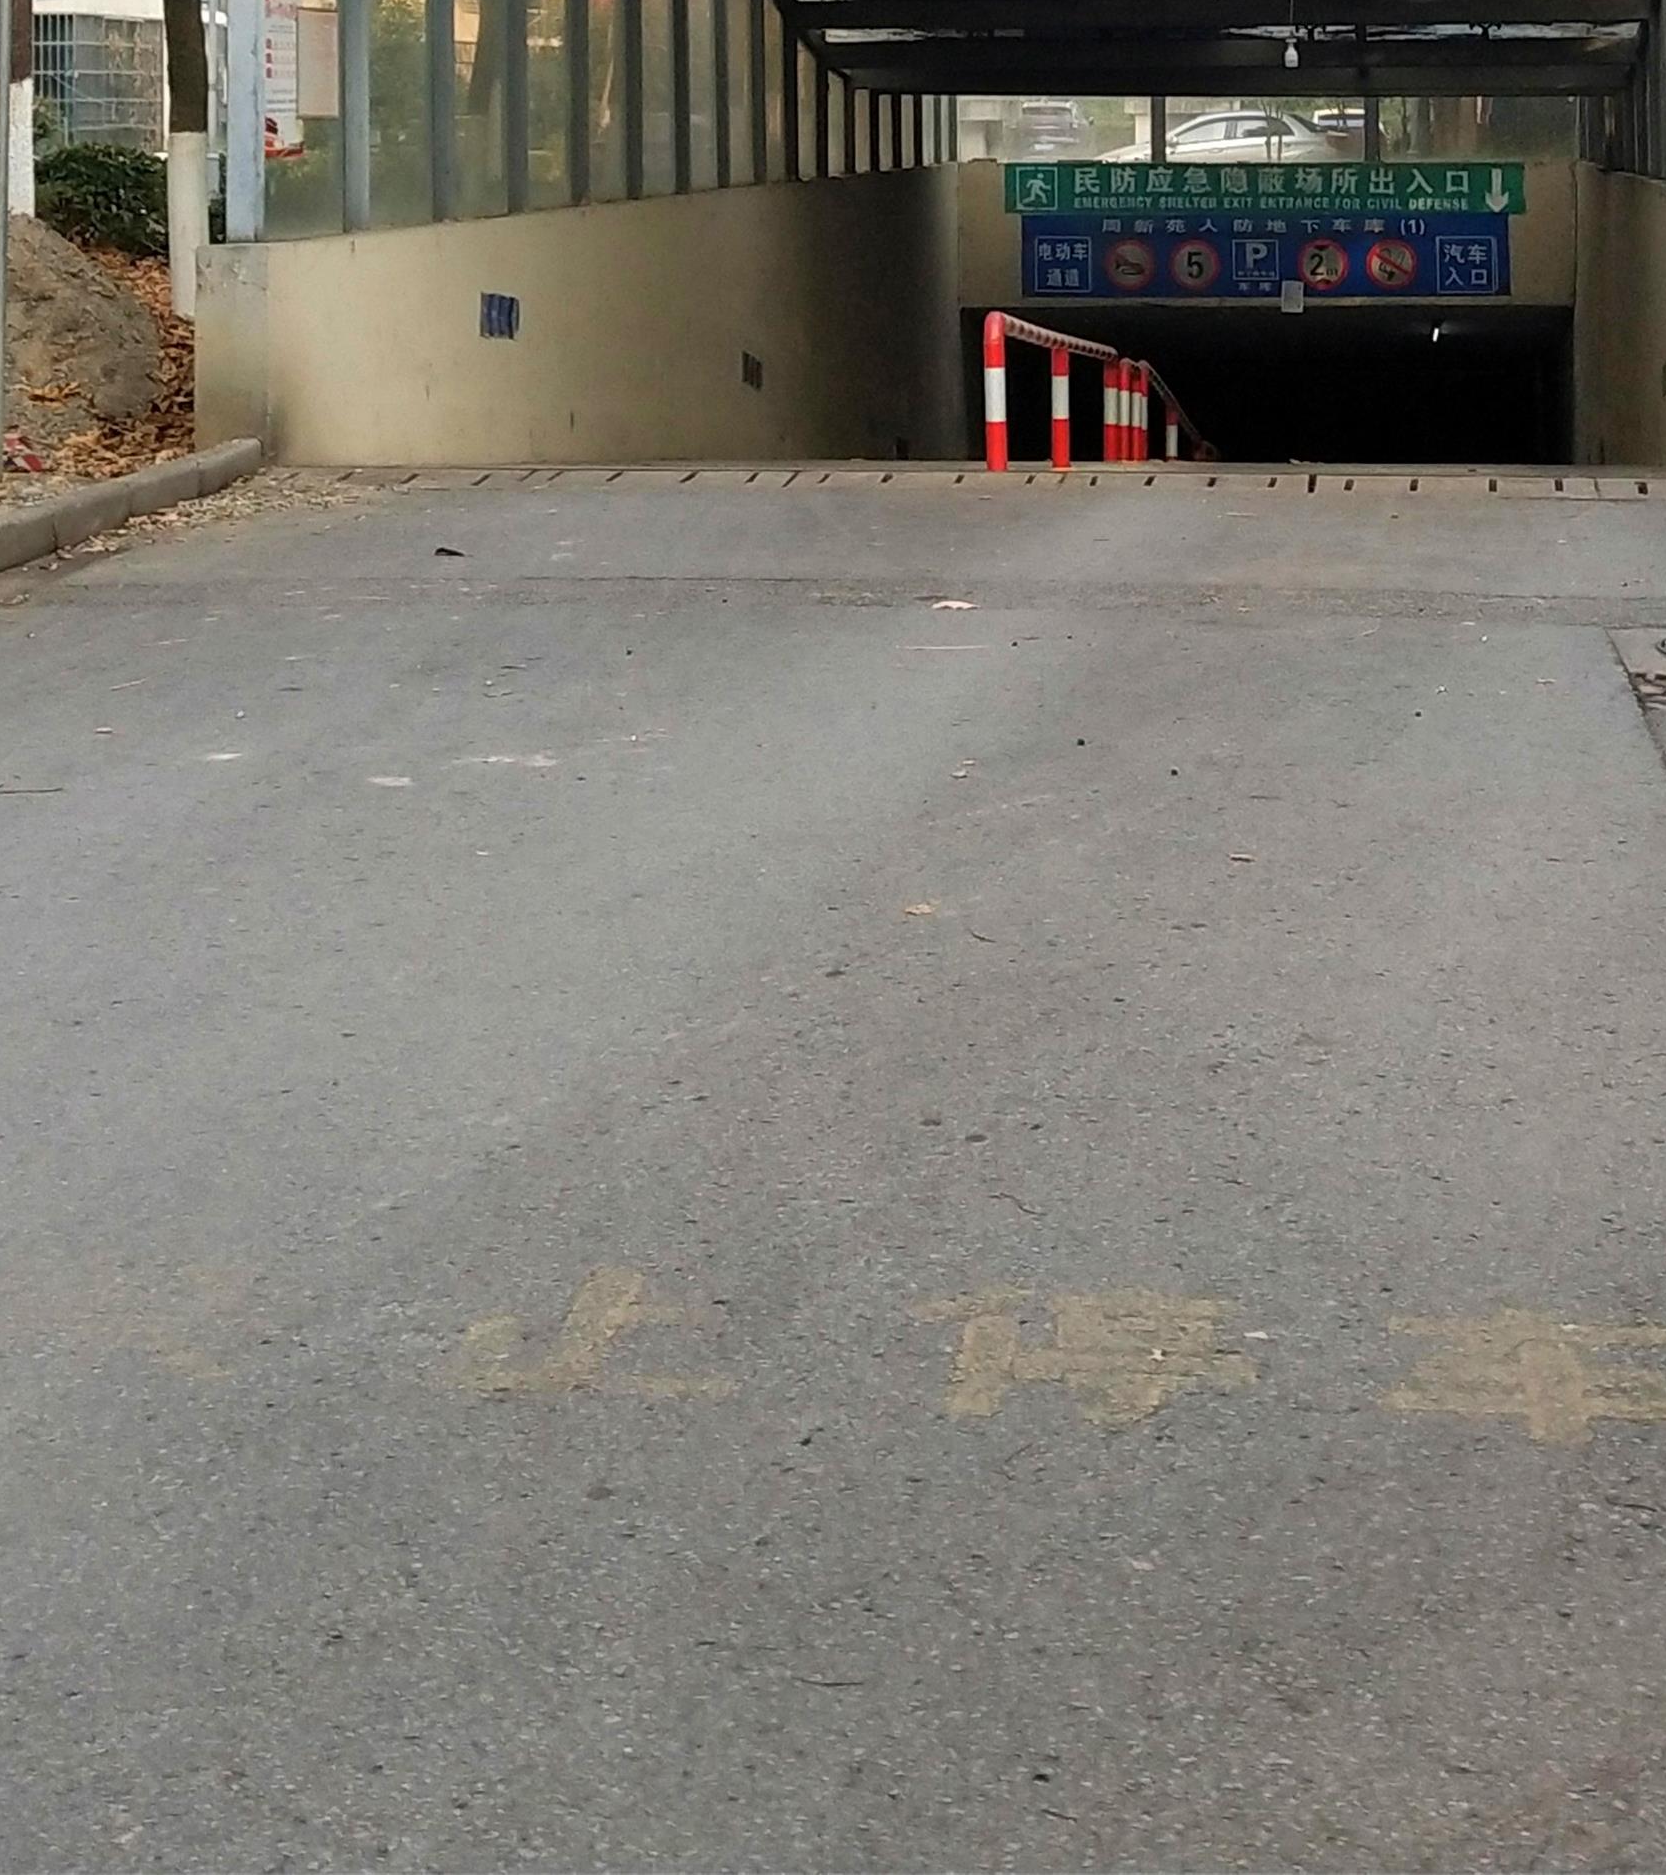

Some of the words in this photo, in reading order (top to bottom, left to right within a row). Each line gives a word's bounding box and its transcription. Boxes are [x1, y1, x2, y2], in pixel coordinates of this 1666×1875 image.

[1073, 166, 1470, 195] 民防应急隐蔽场所出入口
[1073, 196, 1154, 210] EMERGENCY
[1223, 197, 1252, 210] EXIT
[1260, 197, 1330, 210] ENTRANCE
[1334, 197, 1361, 210] FOR
[1367, 197, 1402, 210] CIVIL
[1408, 197, 1469, 211] DEFENSE
[1038, 242, 1089, 261] 电动车
[1244, 242, 1268, 269] P
[1443, 244, 1487, 264] 汽车
[1186, 251, 1204, 280] 5
[1444, 270, 1488, 286] 入口
